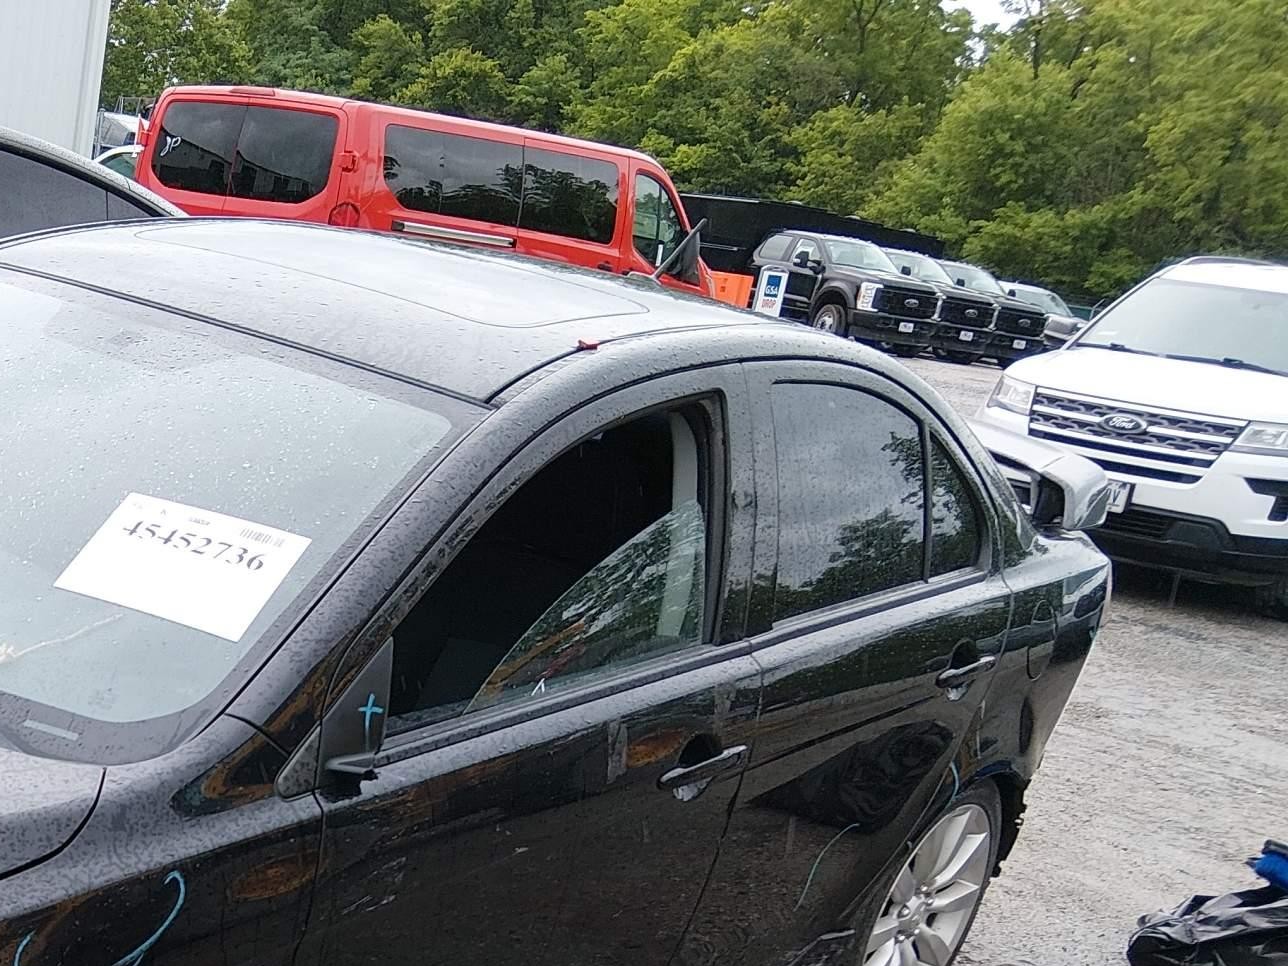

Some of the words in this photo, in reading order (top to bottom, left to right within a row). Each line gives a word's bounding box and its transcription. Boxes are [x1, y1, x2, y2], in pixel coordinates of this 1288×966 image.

[765, 285, 778, 294] GSA
[1109, 417, 1136, 429] Ford
[123, 520, 265, 571] 45452736
